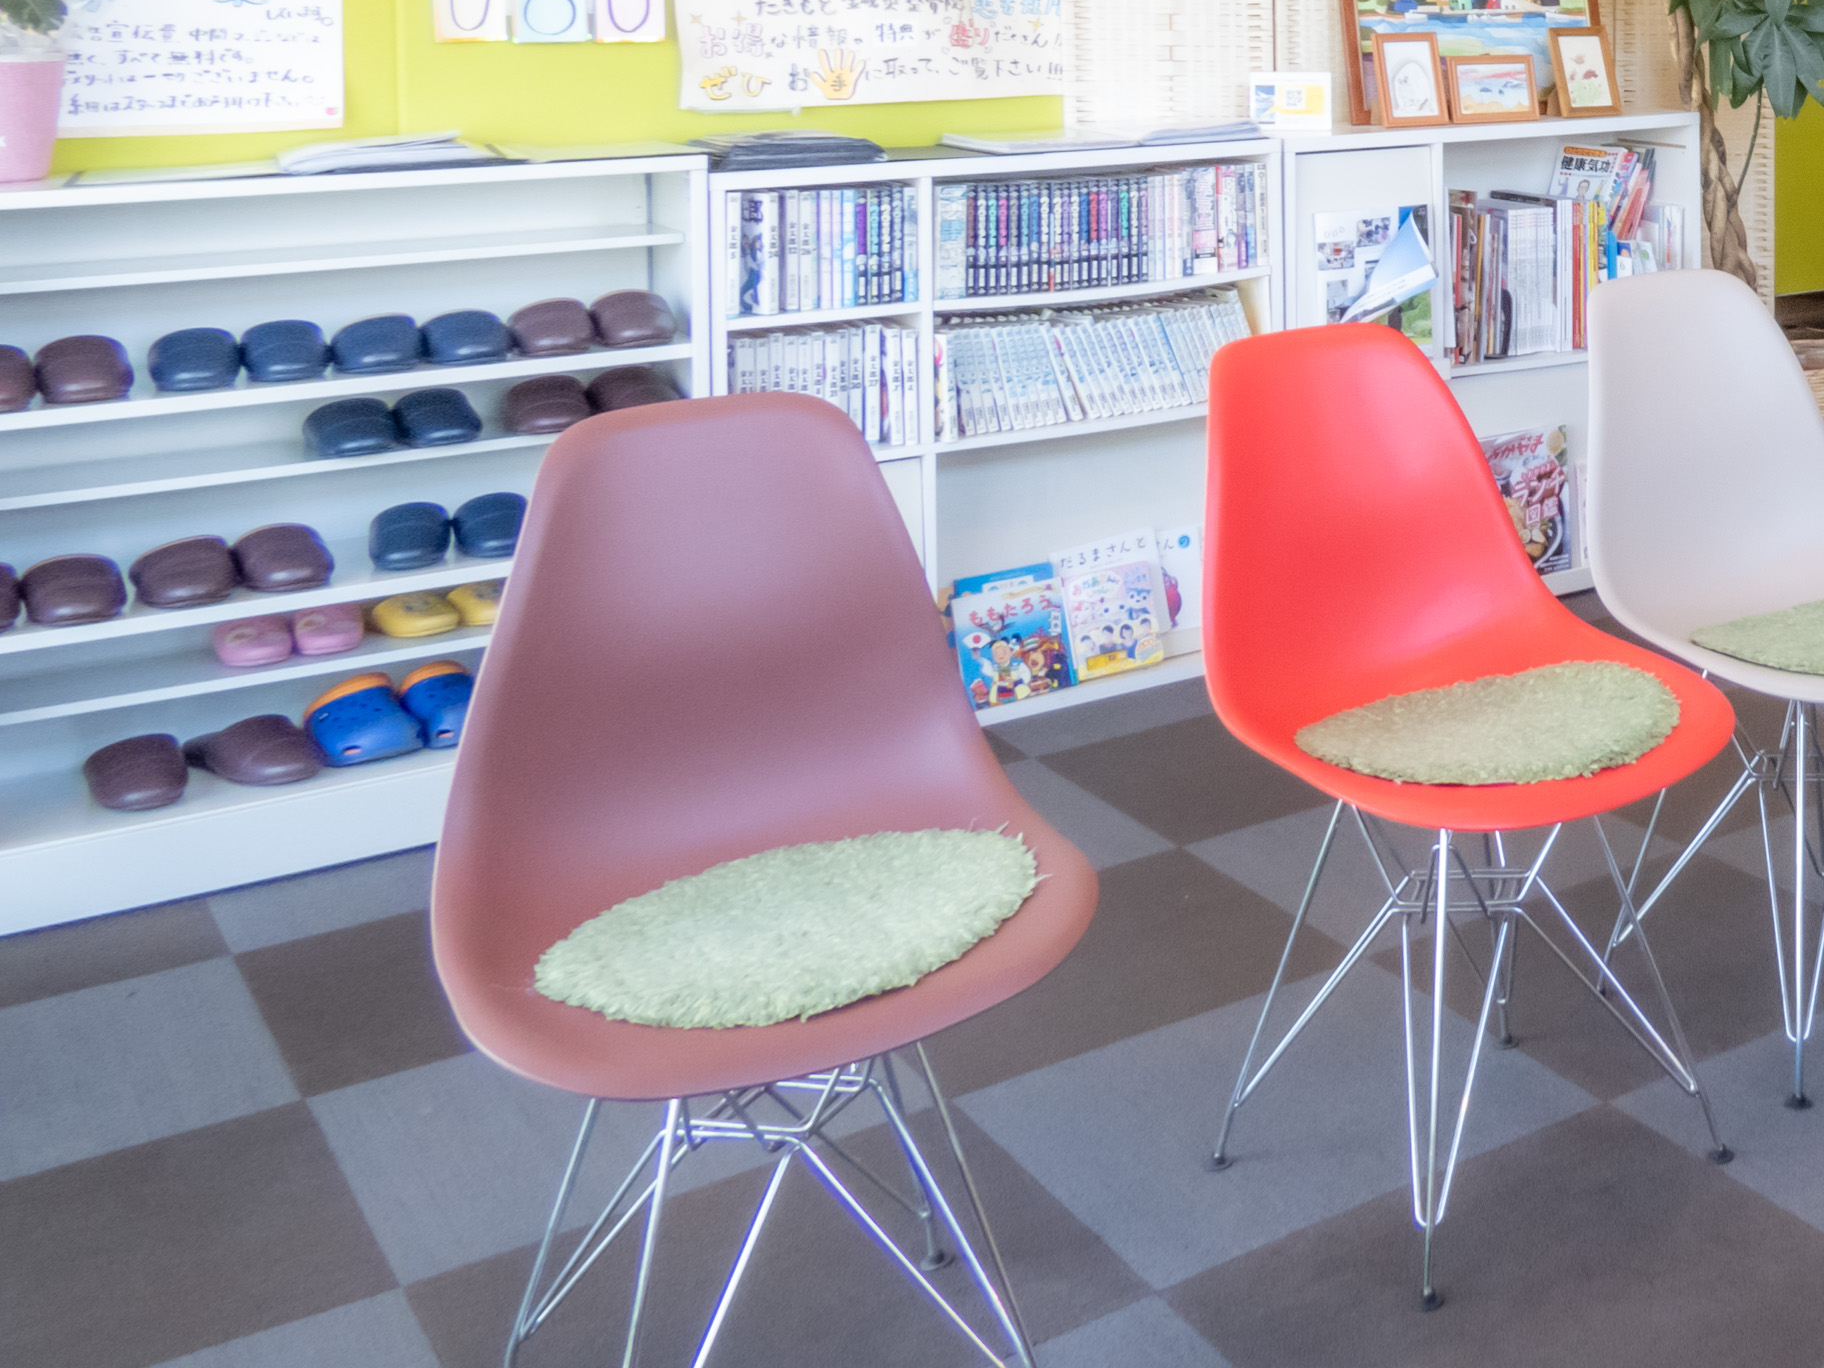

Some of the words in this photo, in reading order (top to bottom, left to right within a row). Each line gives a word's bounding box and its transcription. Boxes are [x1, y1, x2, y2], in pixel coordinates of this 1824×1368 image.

[1511, 465, 1566, 508] ランチ
[968, 593, 1055, 626] ももたろう
